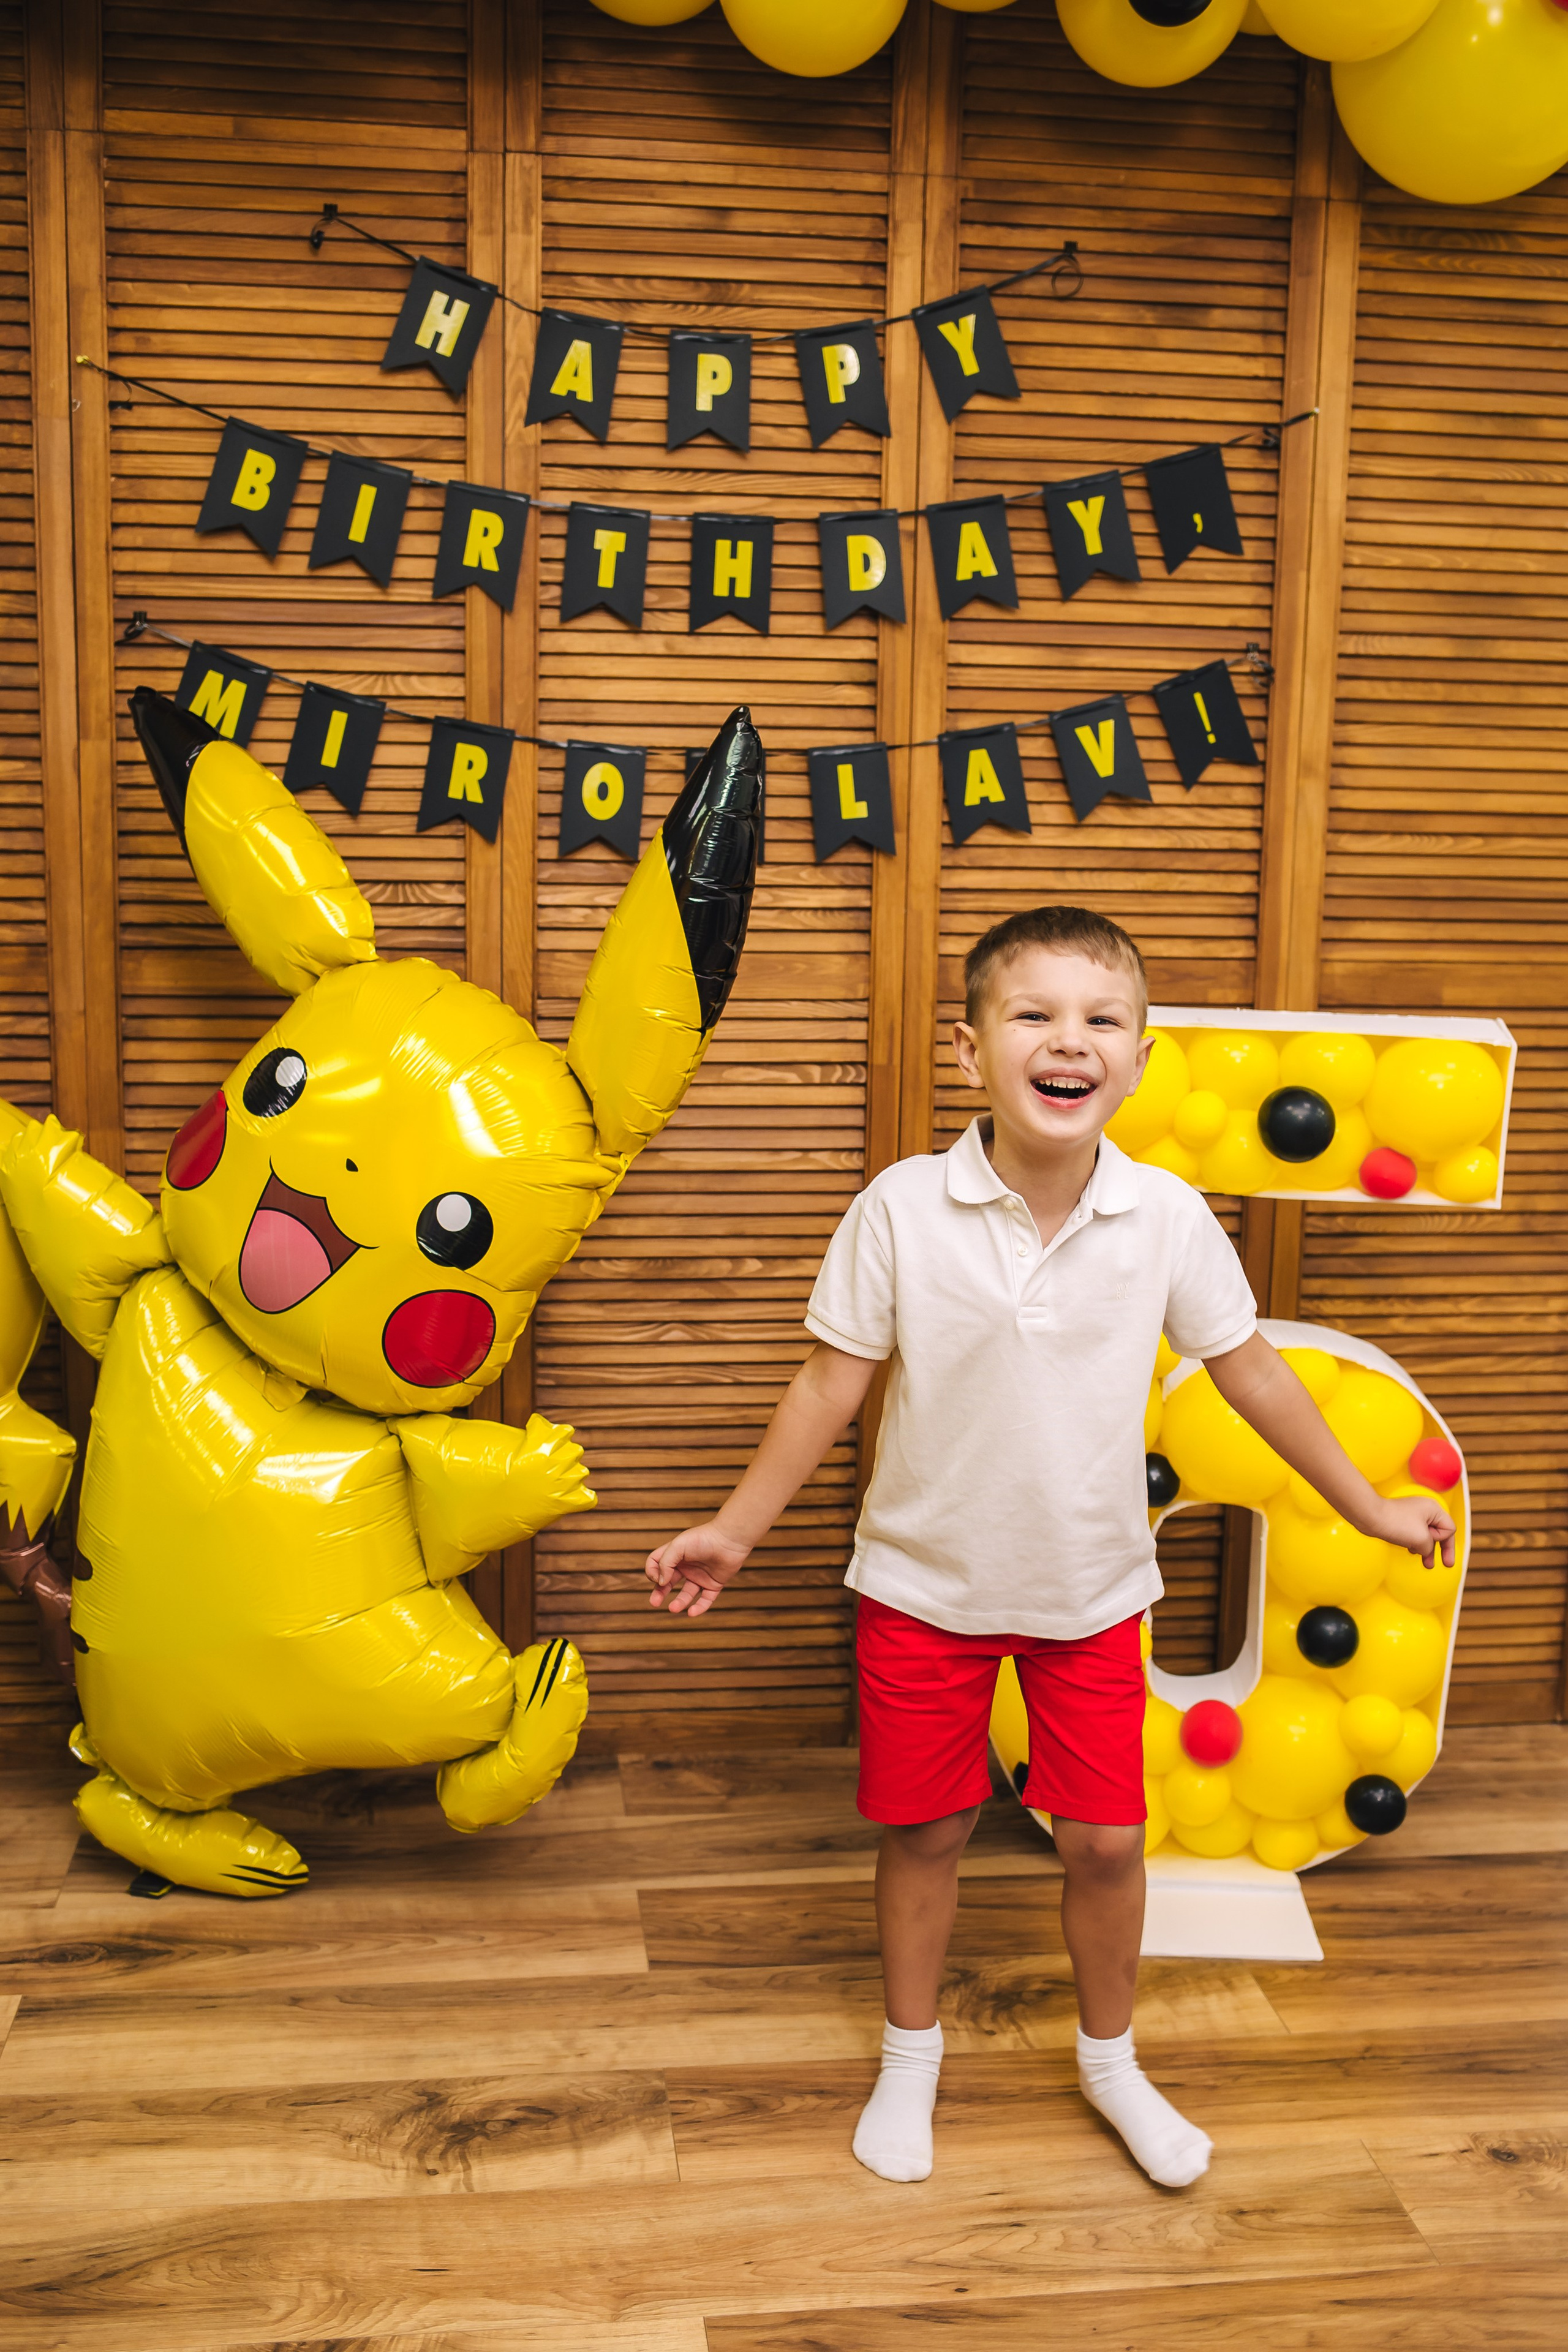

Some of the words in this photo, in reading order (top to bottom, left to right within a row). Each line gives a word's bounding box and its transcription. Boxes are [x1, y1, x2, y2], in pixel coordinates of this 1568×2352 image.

[414, 290, 981, 412] HAPPY
[230, 448, 1204, 598] BIRTHDAY,
[189, 669, 1218, 821] MIROLAV!
